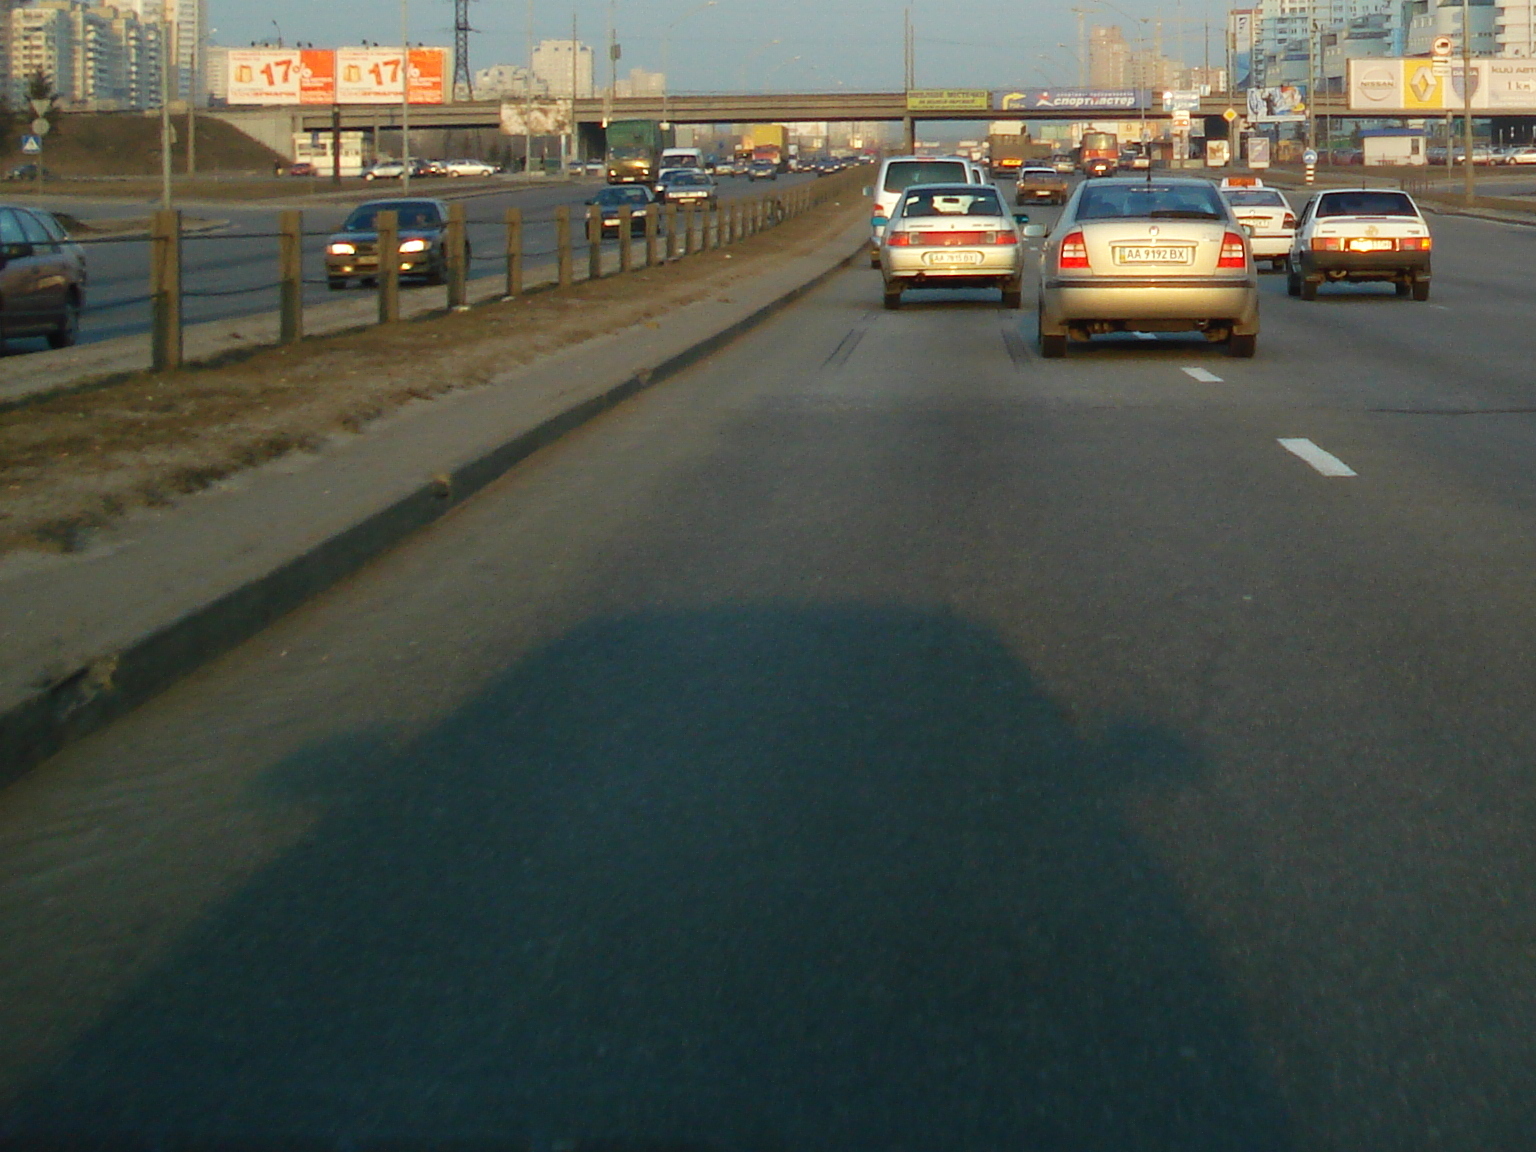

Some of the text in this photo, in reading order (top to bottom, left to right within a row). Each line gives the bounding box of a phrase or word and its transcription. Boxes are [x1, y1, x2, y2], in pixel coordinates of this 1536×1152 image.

[1127, 249, 1185, 260] AA 9192 BX
